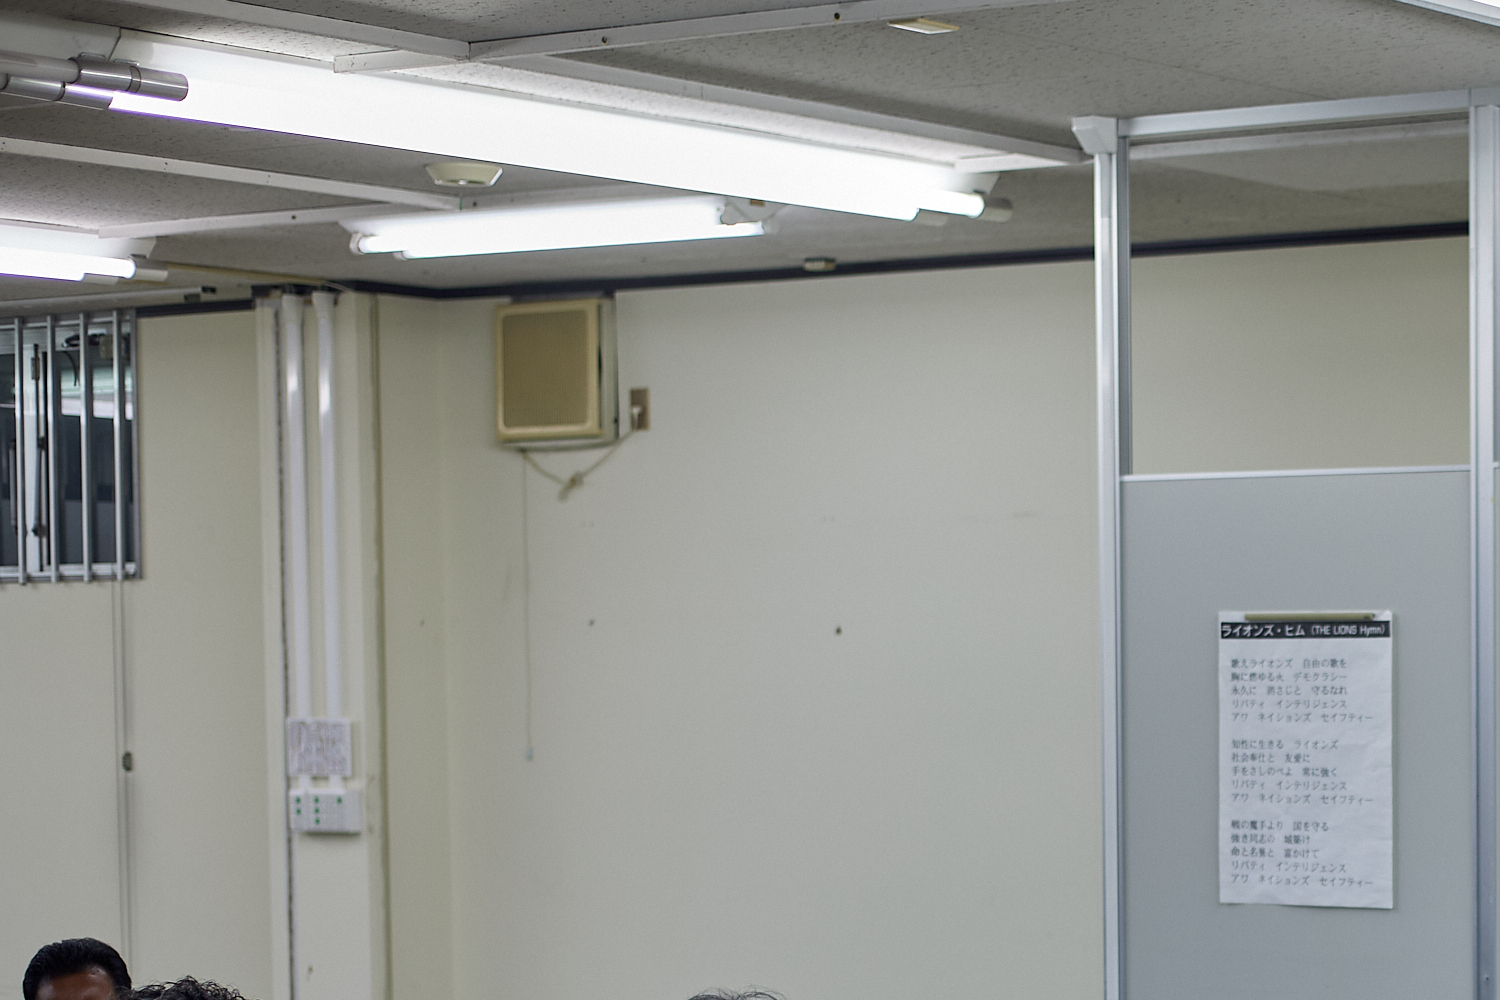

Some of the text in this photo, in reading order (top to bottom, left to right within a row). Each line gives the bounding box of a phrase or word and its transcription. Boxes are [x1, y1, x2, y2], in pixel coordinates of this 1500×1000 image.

[1221, 624, 1305, 638] ライオンズ・ヒム
[1333, 625, 1357, 635] LIONS
[1293, 672, 1347, 682] デモクラシー
[1275, 700, 1347, 709] インテリジェンス
[1258, 713, 1312, 723] ネイションズ
[1321, 713, 1373, 723] セイフティー
[1294, 740, 1339, 750] ライオンズ
[1275, 781, 1347, 791] インテリジェンス
[1259, 794, 1311, 804] ネイションズ
[1320, 795, 1373, 805] セイフティー
[1275, 862, 1347, 873] インテリジェンス
[1258, 875, 1310, 885] ネイションズ
[1319, 877, 1373, 887] セイフティー
